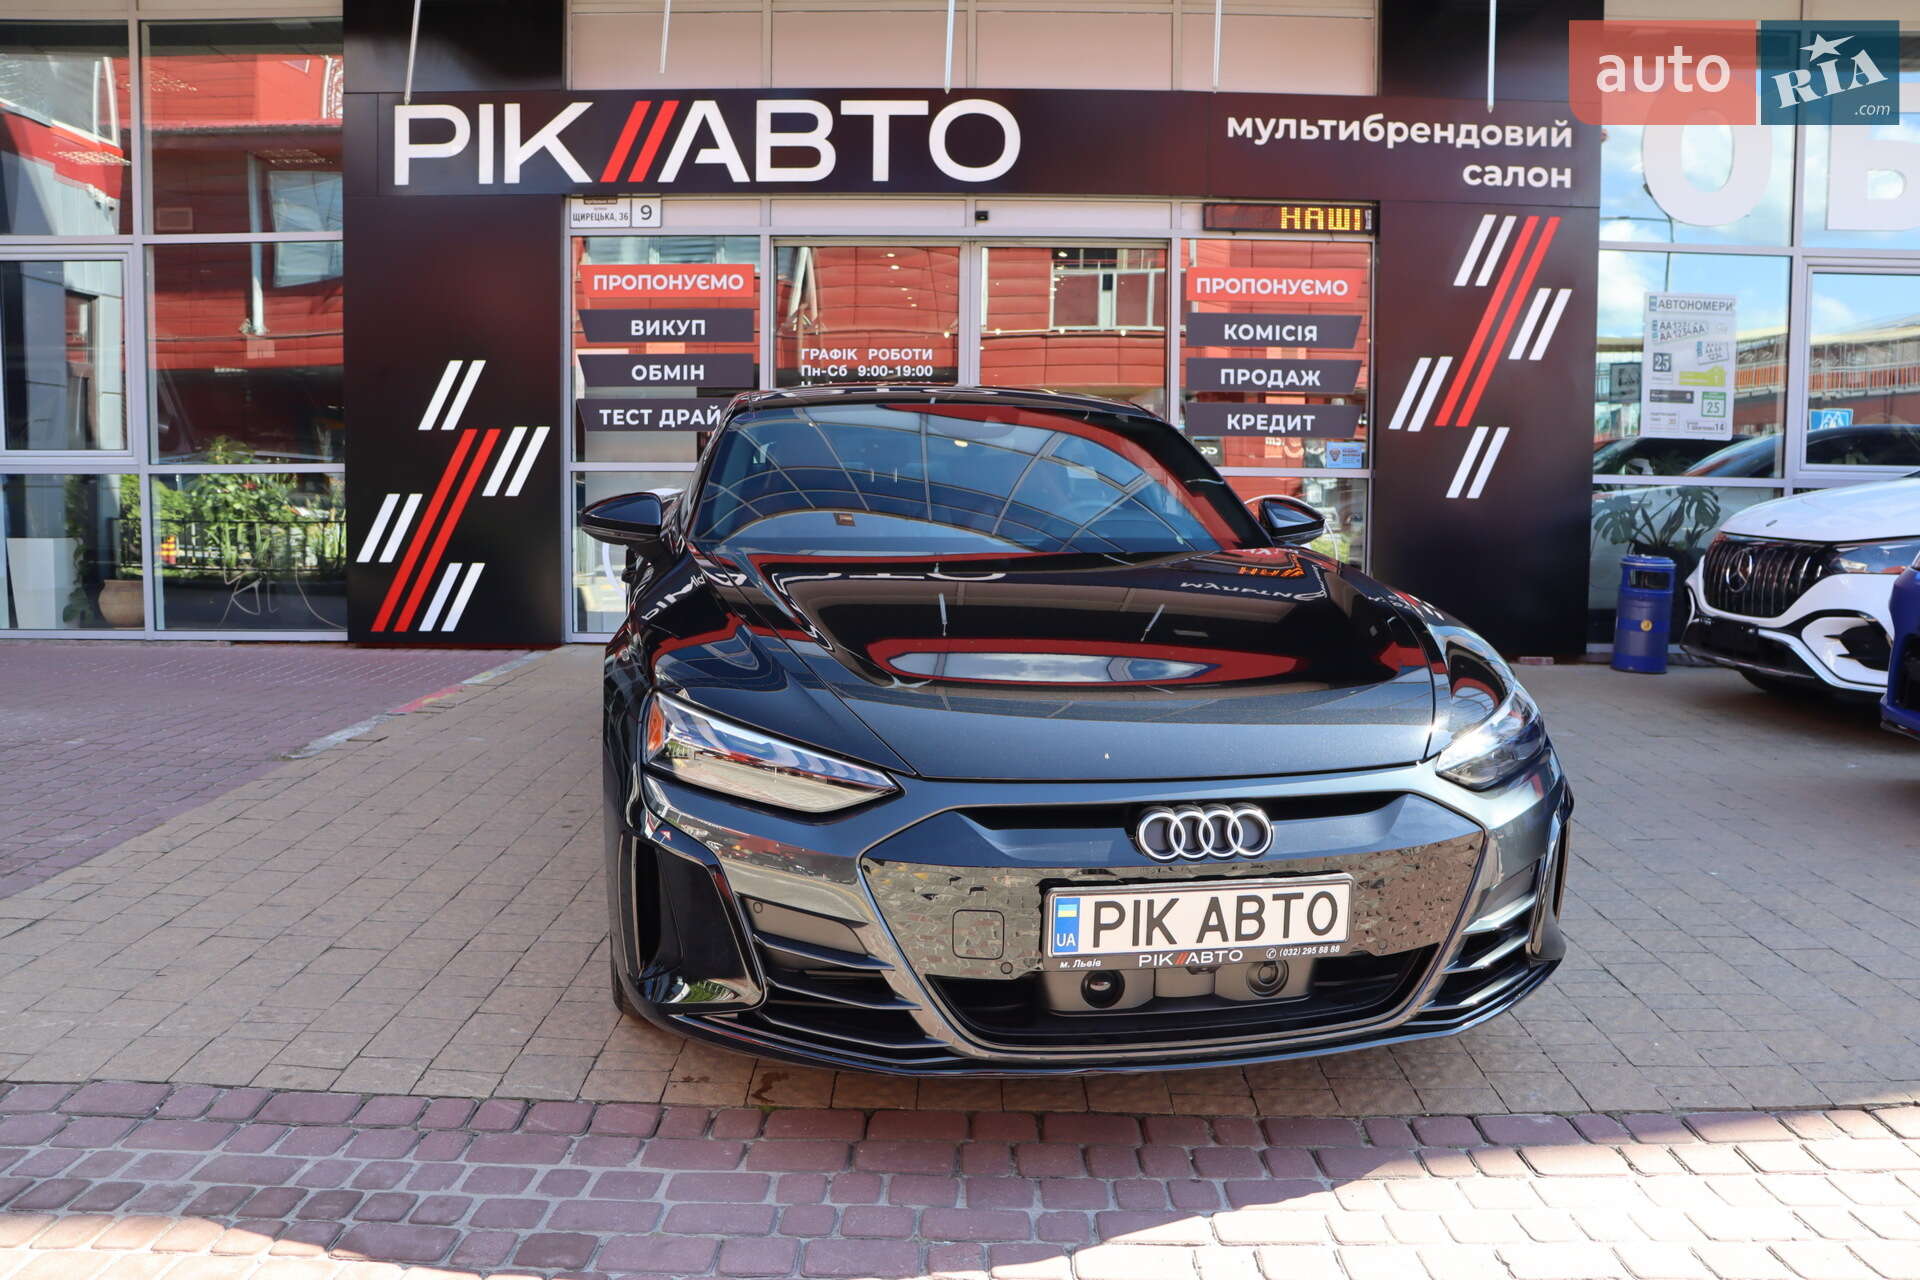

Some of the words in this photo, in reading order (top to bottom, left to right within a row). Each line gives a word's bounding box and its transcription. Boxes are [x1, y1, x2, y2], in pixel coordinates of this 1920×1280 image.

[1227, 113, 1573, 149] мультибрендовий
[1462, 164, 1572, 189] салон
[620, 212, 629, 221] 36
[640, 204, 652, 221] 9
[593, 274, 744, 291] ПРОПОНУЄМО
[1196, 277, 1349, 296] ПРОПОНУЄМО
[1658, 299, 1734, 312] АВТОНОМЕРИ
[631, 319, 706, 336] ВИКУП
[1224, 323, 1318, 342] КОМІСІЯ
[801, 348, 858, 361] ГРАФІК
[868, 348, 933, 361] РОБОТИ
[1653, 354, 1671, 370] 25
[631, 364, 705, 381] ОБМІН
[801, 365, 848, 377] Пн-Сб
[857, 365, 933, 377] 9:00-19:00
[1220, 368, 1321, 388] ПРОДАЖ
[1706, 401, 1721, 414] 25
[599, 409, 653, 426] ТЕСТ
[1226, 413, 1316, 432] КРЕДИТ
[1056, 932, 1076, 947] UA
